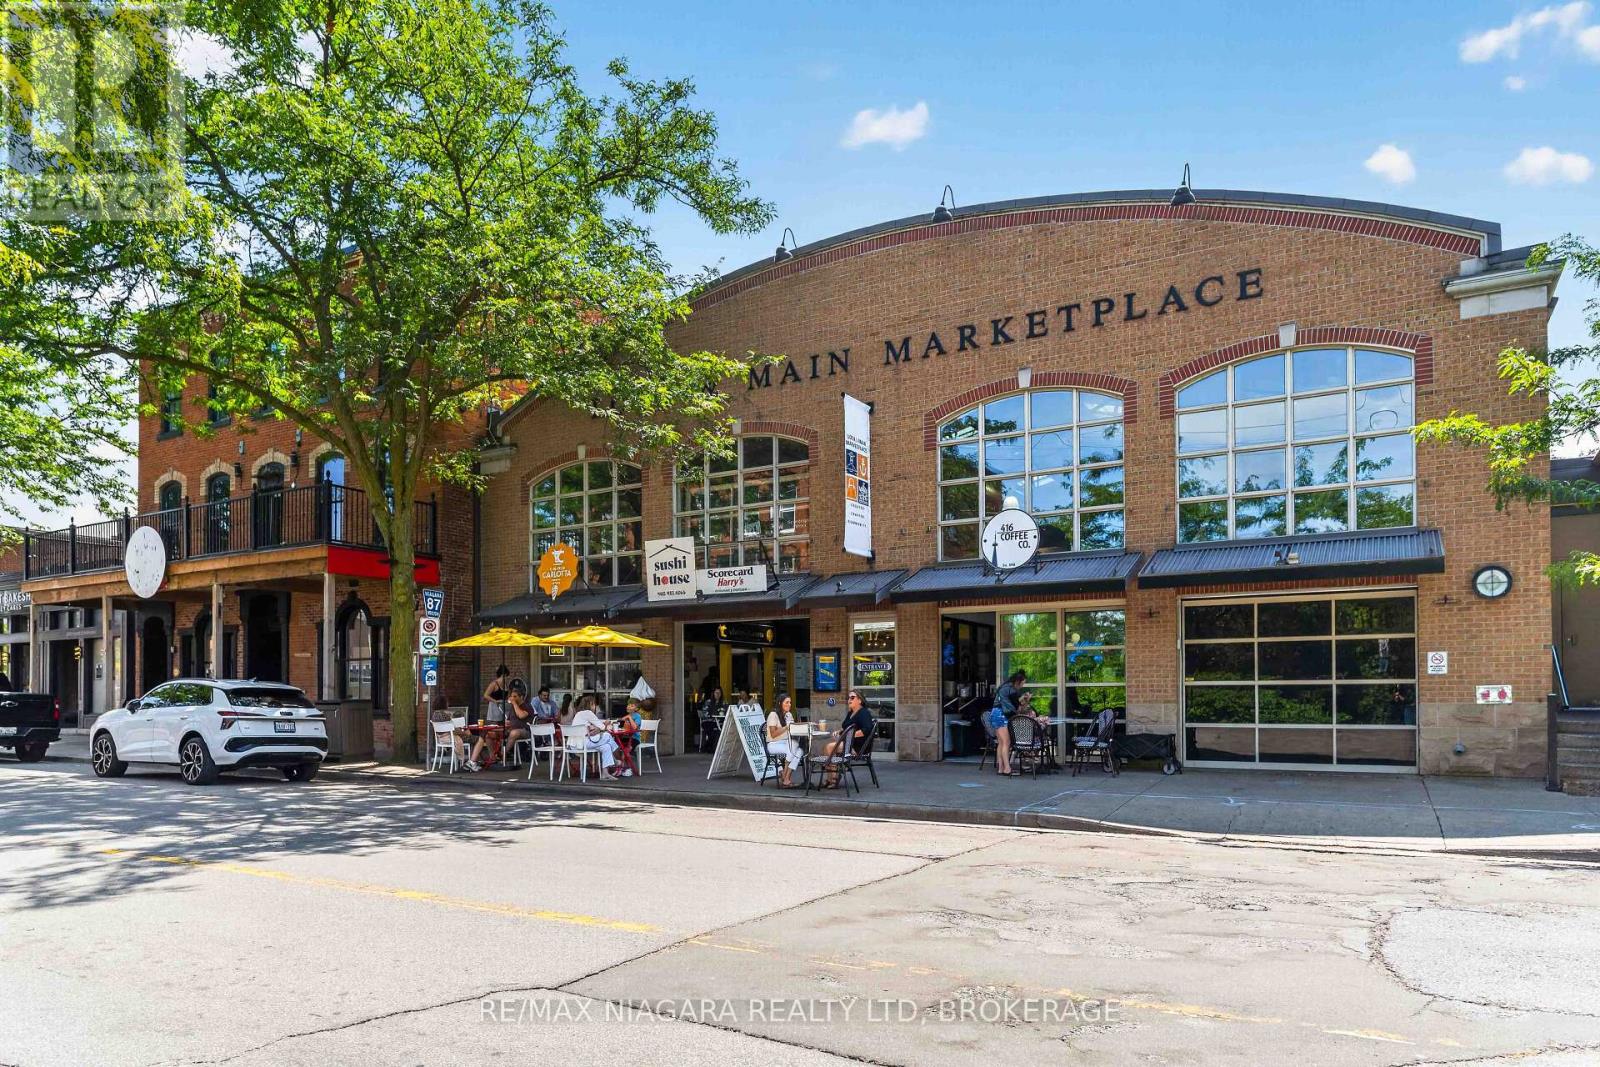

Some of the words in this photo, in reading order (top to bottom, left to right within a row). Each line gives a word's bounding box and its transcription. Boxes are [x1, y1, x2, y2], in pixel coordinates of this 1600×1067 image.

[747, 348, 851, 391] MAIN
[884, 267, 1265, 366] MARKETPLACE
[1000, 523, 1014, 532] 416
[1000, 531, 1029, 541] COFFEE
[1018, 540, 1031, 549] CO.
[654, 555, 687, 572] sushi
[707, 566, 754, 579] Scorecard
[653, 573, 690, 586] house
[717, 576, 744, 588] Harry's
[427, 597, 441, 611] 87
[861, 663, 889, 671] ENTRANCE
